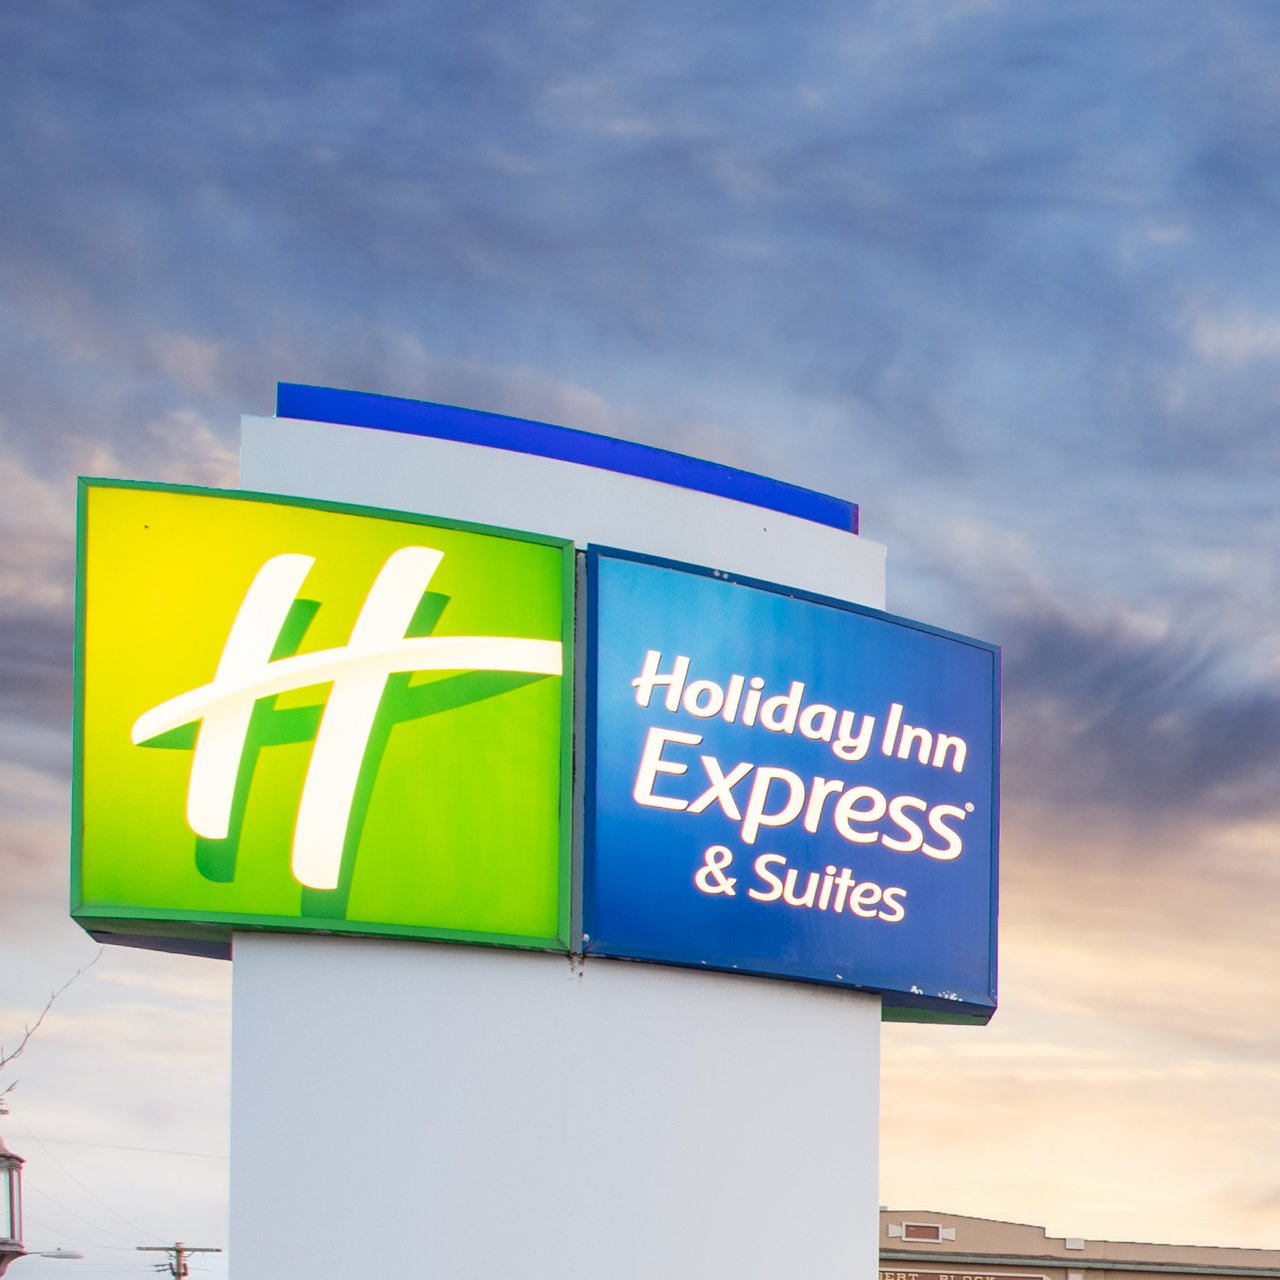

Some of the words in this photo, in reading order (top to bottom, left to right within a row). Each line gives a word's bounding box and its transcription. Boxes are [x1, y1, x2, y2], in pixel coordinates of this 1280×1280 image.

[631, 650, 876, 762] Holiday
[881, 702, 968, 774] Inn
[632, 727, 967, 861] Express
[694, 844, 738, 896] &
[748, 852, 908, 923] Suites
